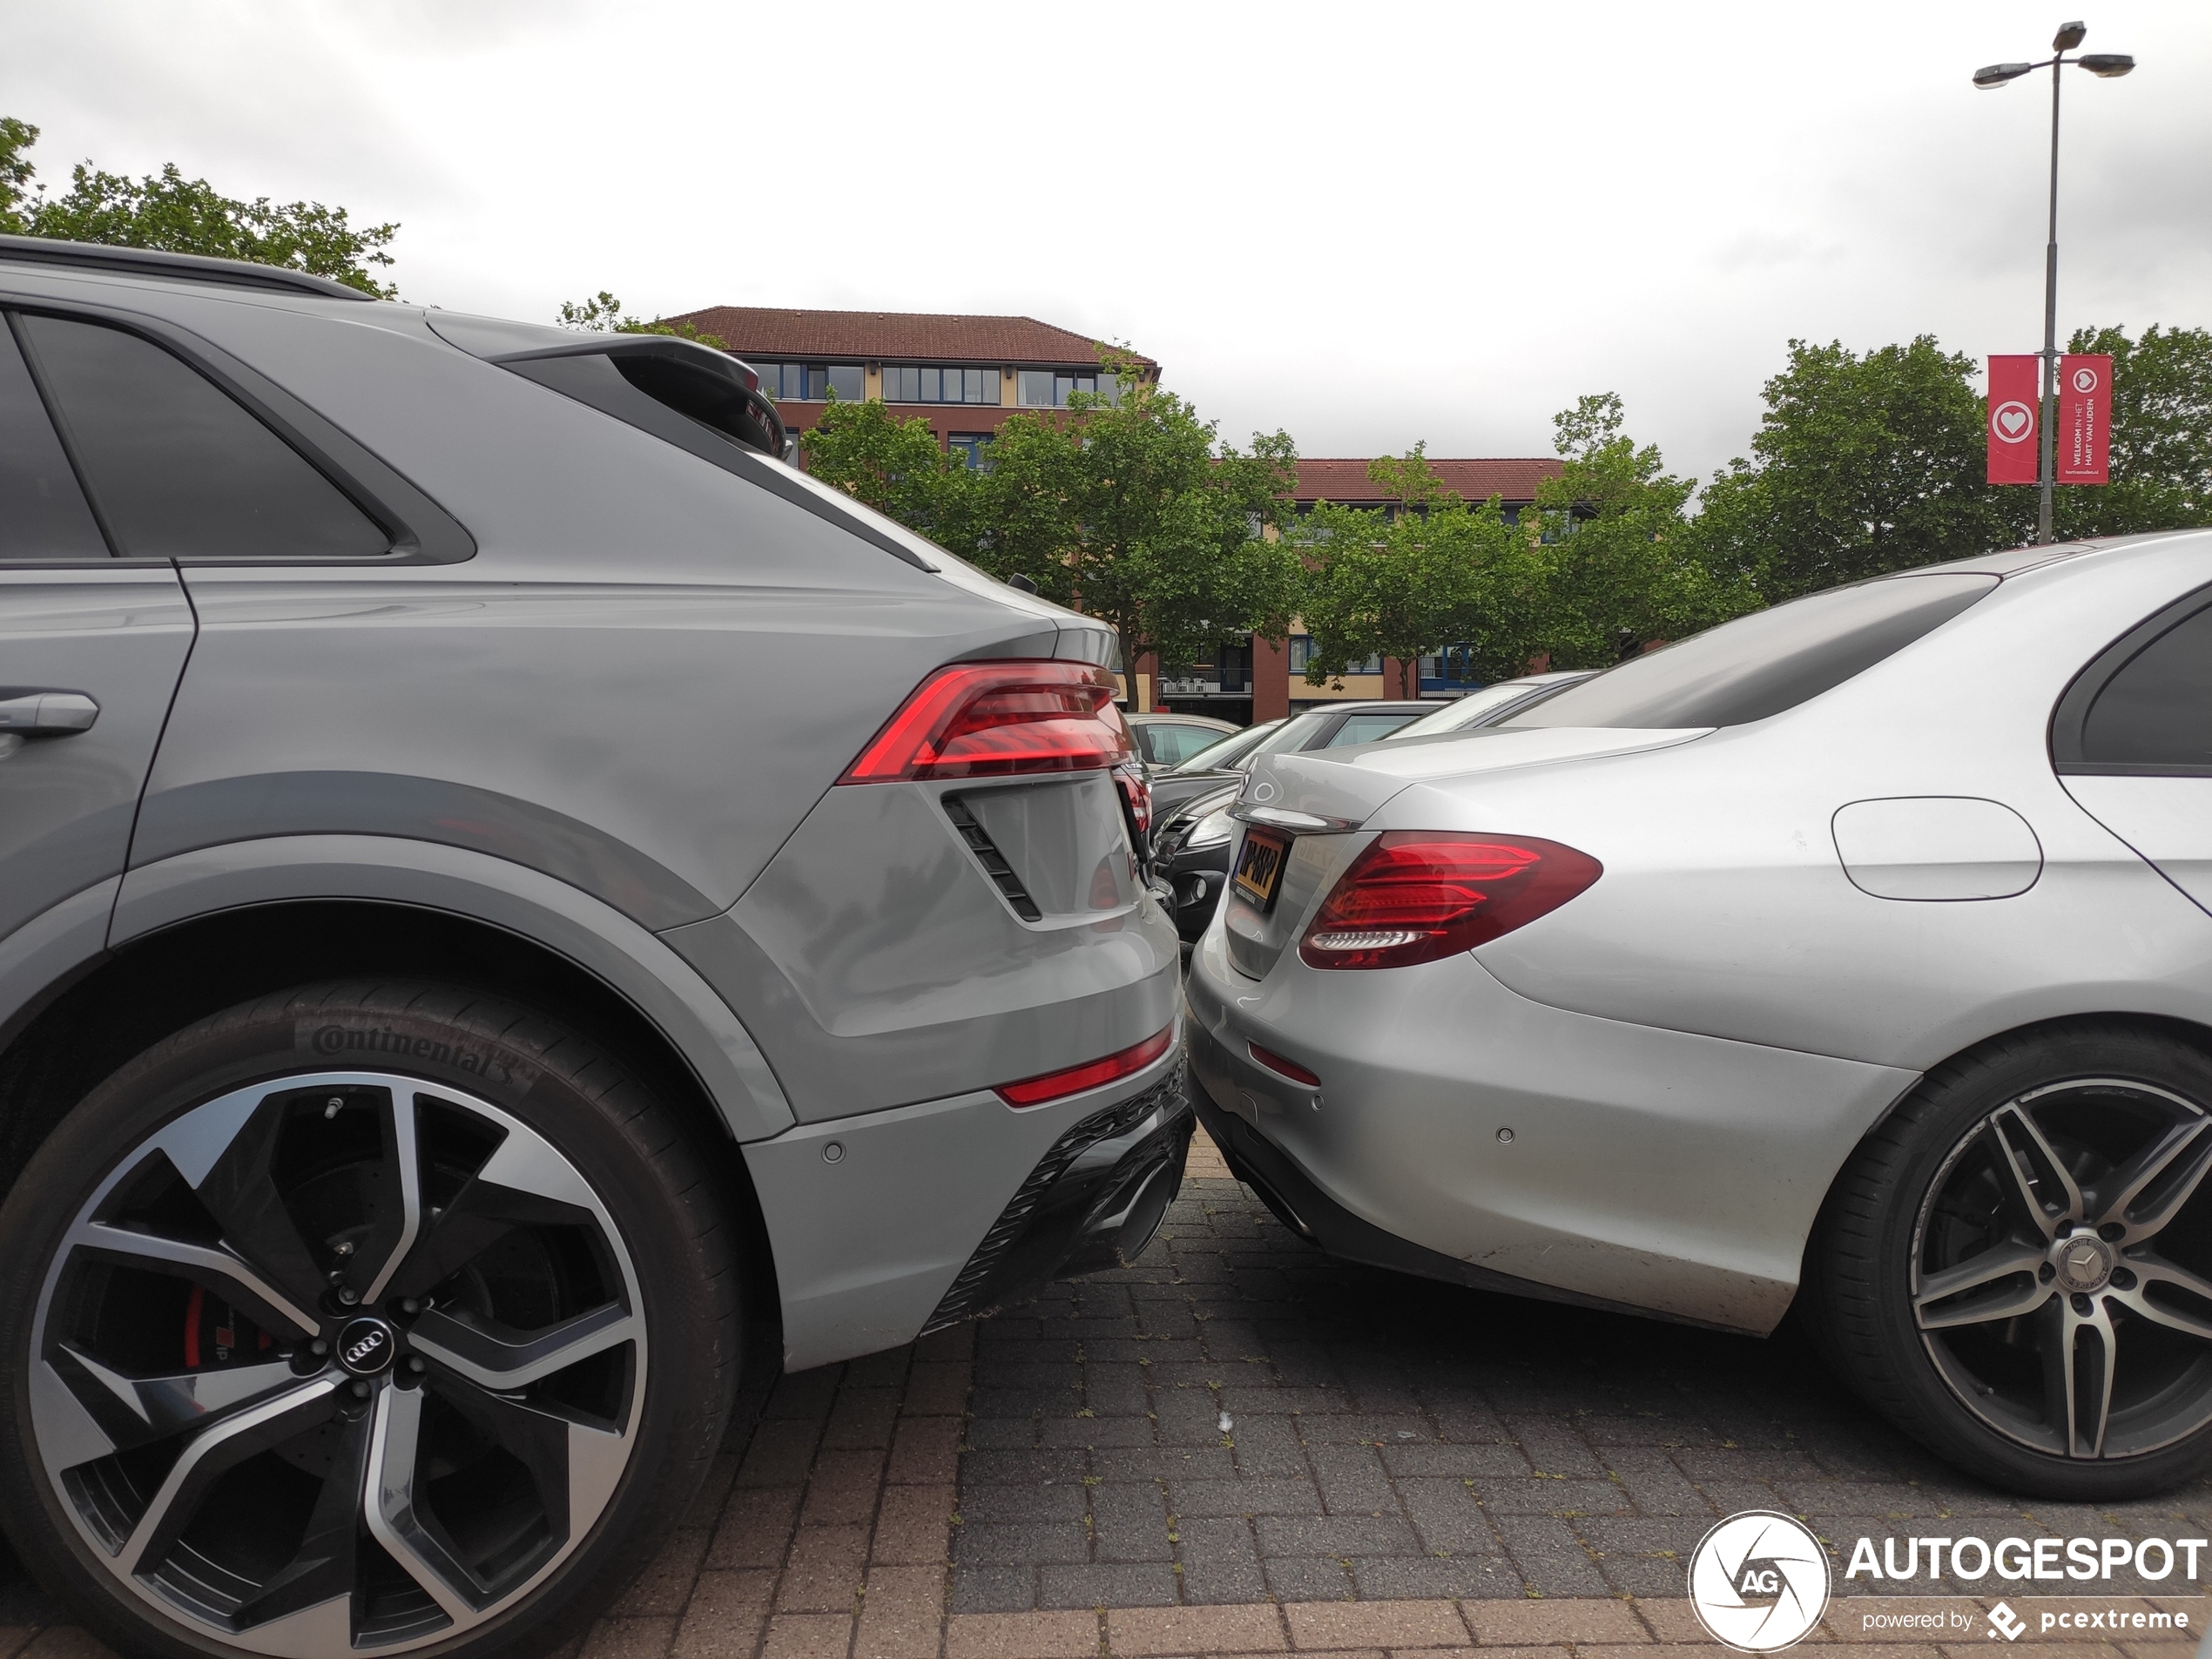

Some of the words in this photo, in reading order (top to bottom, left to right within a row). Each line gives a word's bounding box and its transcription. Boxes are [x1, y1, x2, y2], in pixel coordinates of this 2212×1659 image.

[2074, 402, 2083, 417] HET
[2086, 399, 2094, 423] UDEN
[2074, 419, 2082, 428] IN
[2074, 428, 2082, 467] WELKOM
[311, 1024, 496, 1078] Continental
[2069, 1239, 2087, 1251] BENZ
[2073, 1270, 2107, 1289] MERCEDES
